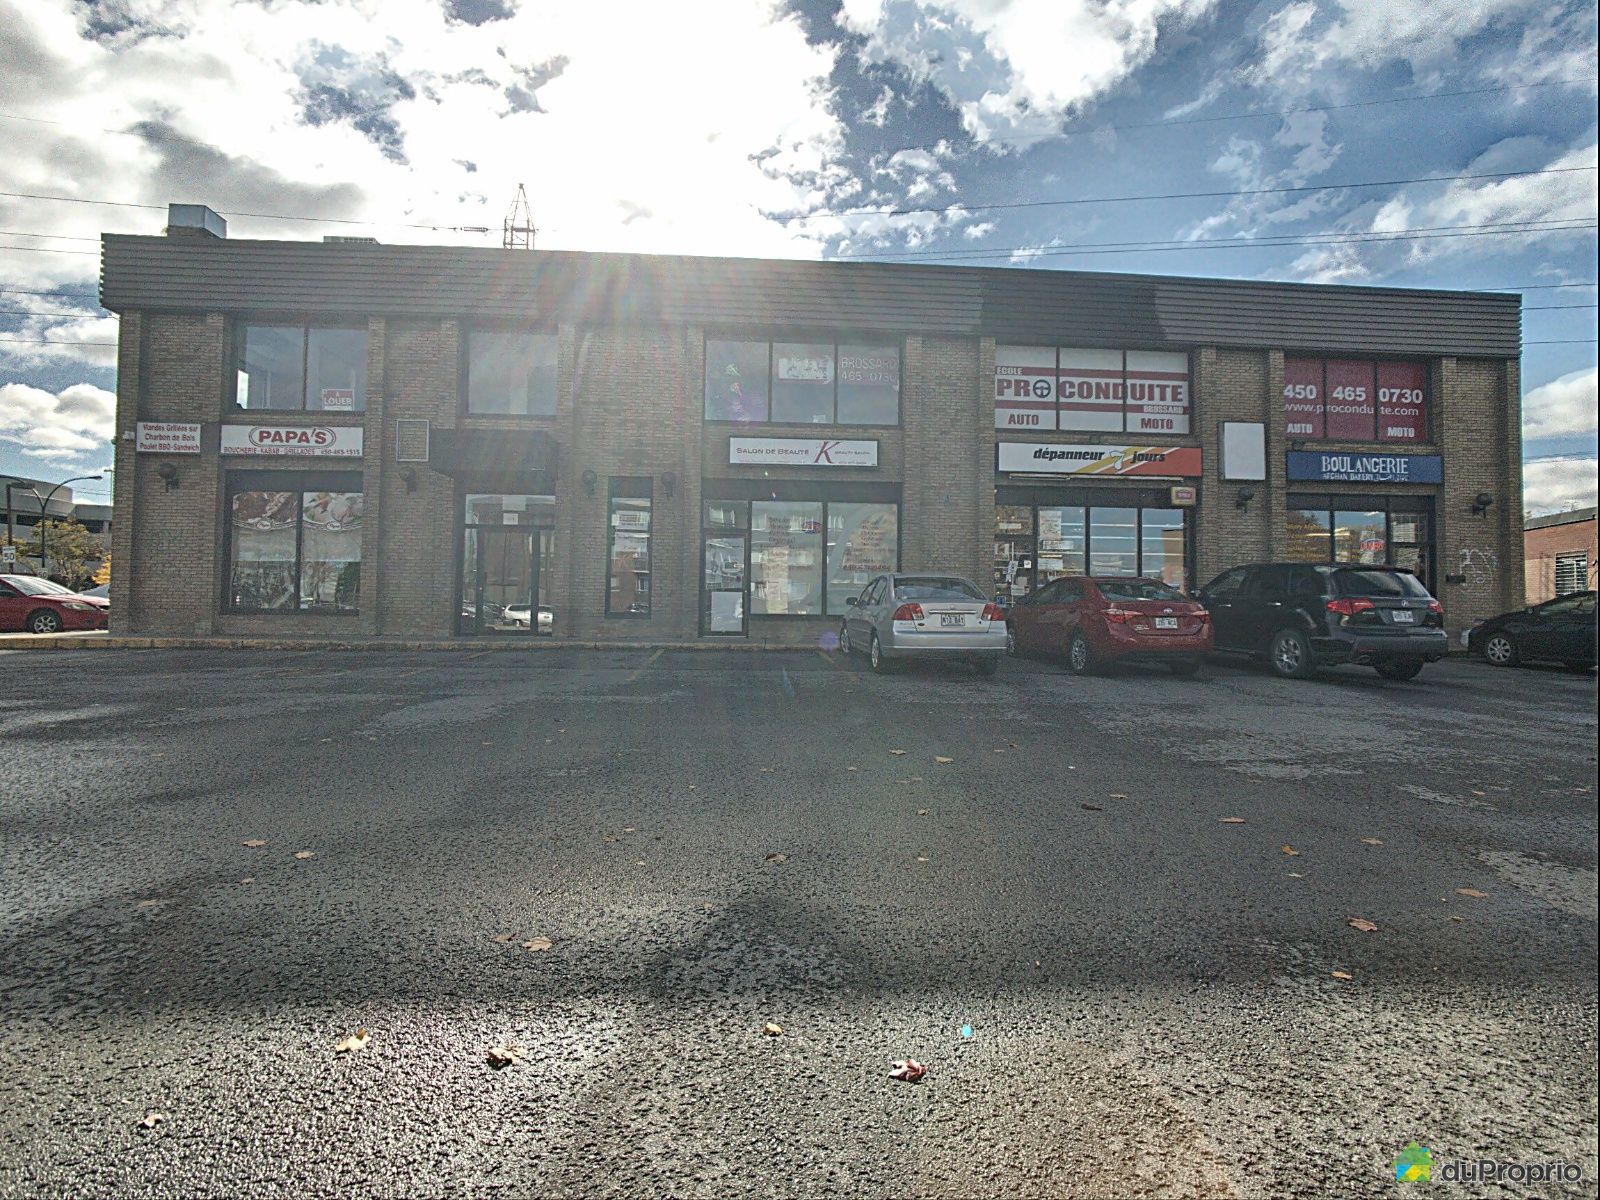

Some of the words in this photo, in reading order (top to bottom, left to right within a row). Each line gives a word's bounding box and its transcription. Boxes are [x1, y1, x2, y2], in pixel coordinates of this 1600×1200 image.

[841, 357, 897, 369] BROSSARD
[841, 370, 863, 381] 465
[1059, 380, 1184, 402] CONDUITE
[1283, 384, 1317, 399] 450
[1332, 386, 1366, 401] 465
[1379, 388, 1423, 404] 0730
[324, 397, 352, 405] LOUER
[1143, 405, 1184, 414] BROSSARD
[1008, 413, 1039, 425] AUTO
[1140, 418, 1174, 430] MOTO
[1286, 423, 1313, 433] AUTO
[1387, 427, 1415, 438] MOTO
[144, 433, 170, 441] Charbon
[258, 427, 327, 445] PAPA'S
[224, 446, 257, 454] BOUCHERIE
[814, 441, 842, 464] K
[1033, 447, 1106, 462] dépanneur
[1109, 449, 1125, 470] 7
[1130, 451, 1167, 464] jours
[1321, 455, 1409, 474] BOULANGERIE
[1349, 473, 1374, 481] BAKERY
[3, 552, 15, 561] 50
